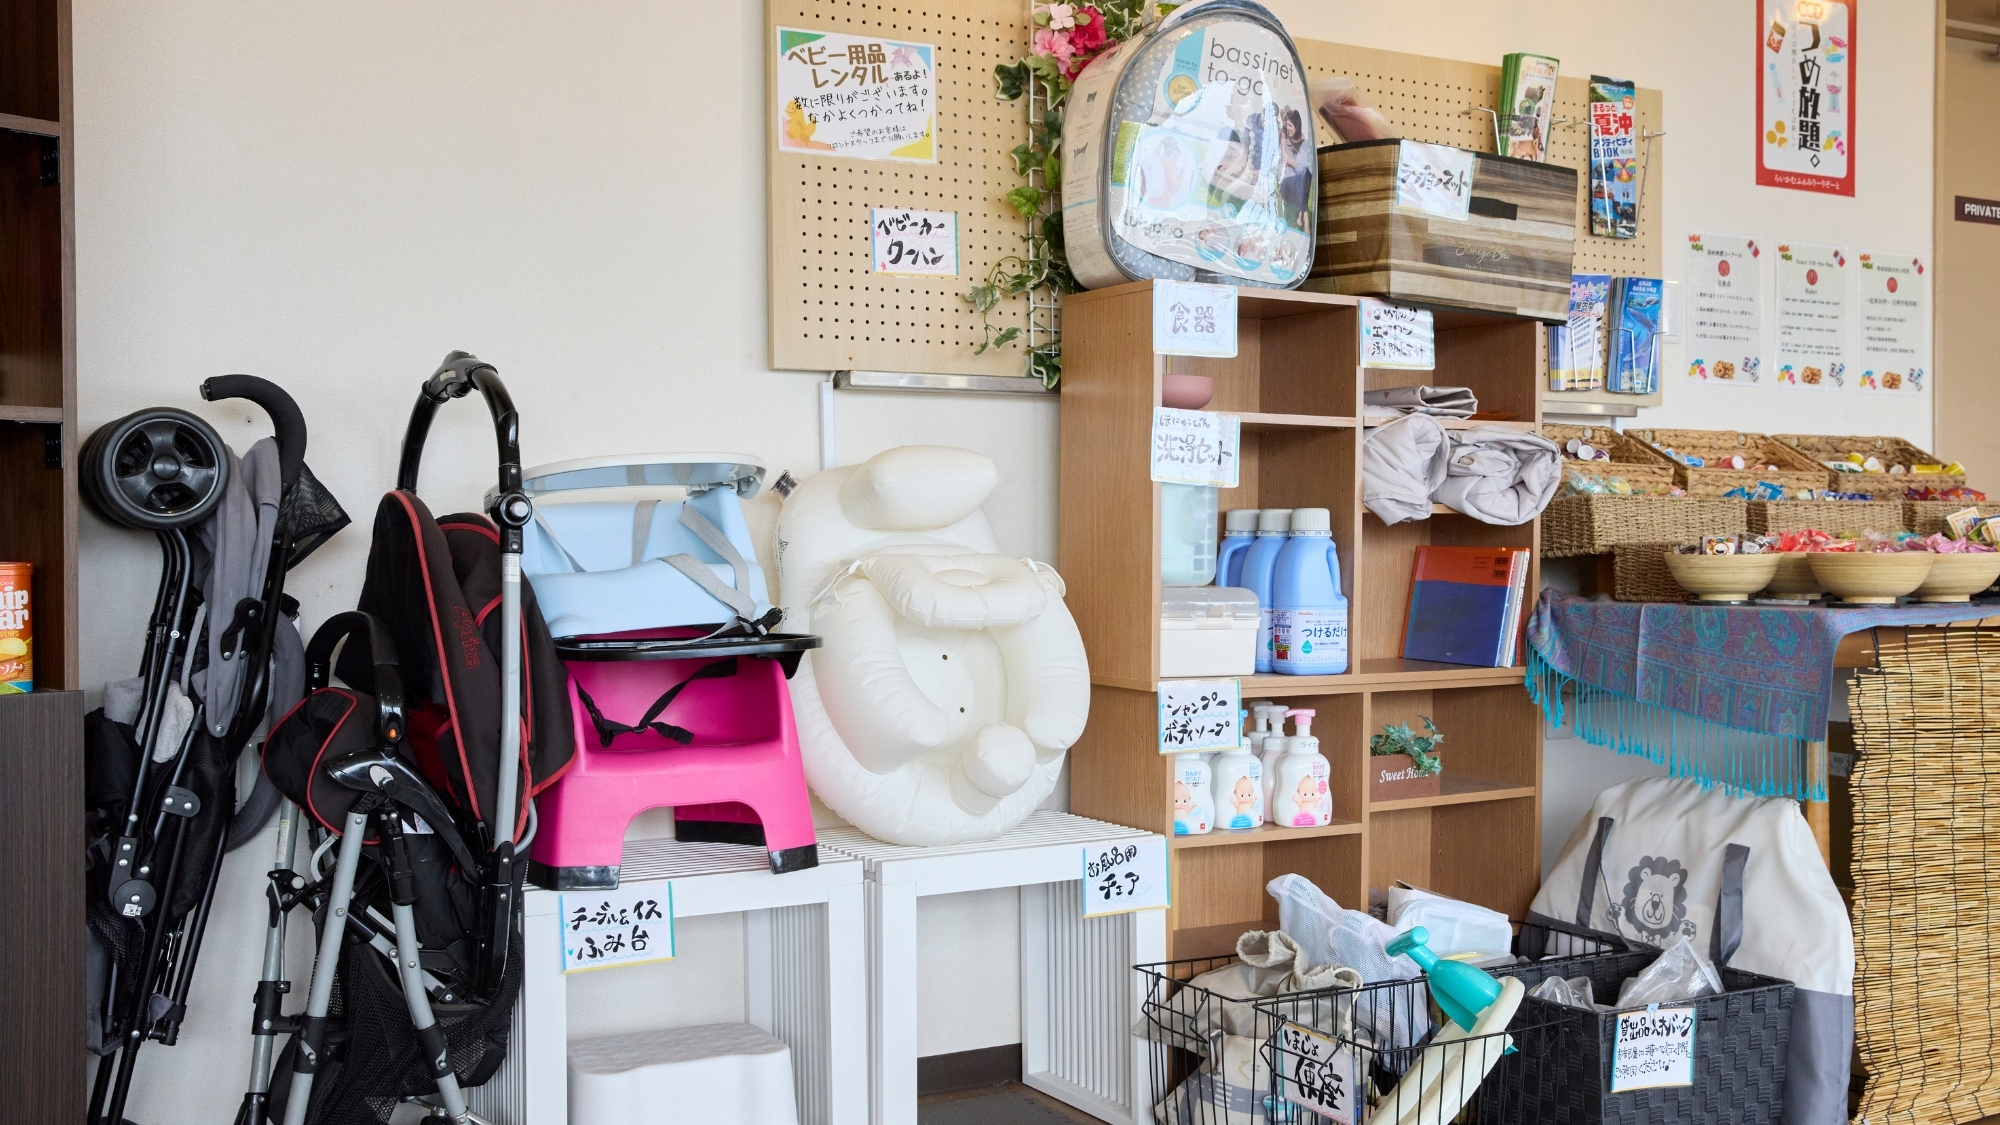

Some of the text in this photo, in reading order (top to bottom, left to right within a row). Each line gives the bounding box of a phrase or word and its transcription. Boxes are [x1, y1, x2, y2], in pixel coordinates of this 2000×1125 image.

[788, 44, 886, 66] ベビー用品
[1210, 37, 1295, 84] bassinet
[811, 64, 889, 88] レンタル
[1207, 63, 1265, 97] to-go
[1593, 103, 1617, 113] まるっと
[1593, 112, 1633, 136] 夏沖
[1964, 203, 2000, 219] PRIVATE
[877, 212, 946, 236] ベビーカー
[1456, 240, 1513, 264] Storage Box
[1169, 302, 1216, 334] 食器
[1157, 433, 1233, 467] 洗浄セット
[1301, 626, 1348, 638] つけるだけ
[1167, 691, 1228, 716] シャンプー
[1163, 718, 1230, 744] ボディソープ
[1379, 769, 1406, 783] Sweet
[1088, 844, 1137, 878] お風呂用
[1099, 872, 1140, 900] チェア
[576, 924, 650, 961] ふみ台
[1283, 1029, 1319, 1058] ほじょ
[1294, 1057, 1345, 1111] 便座
